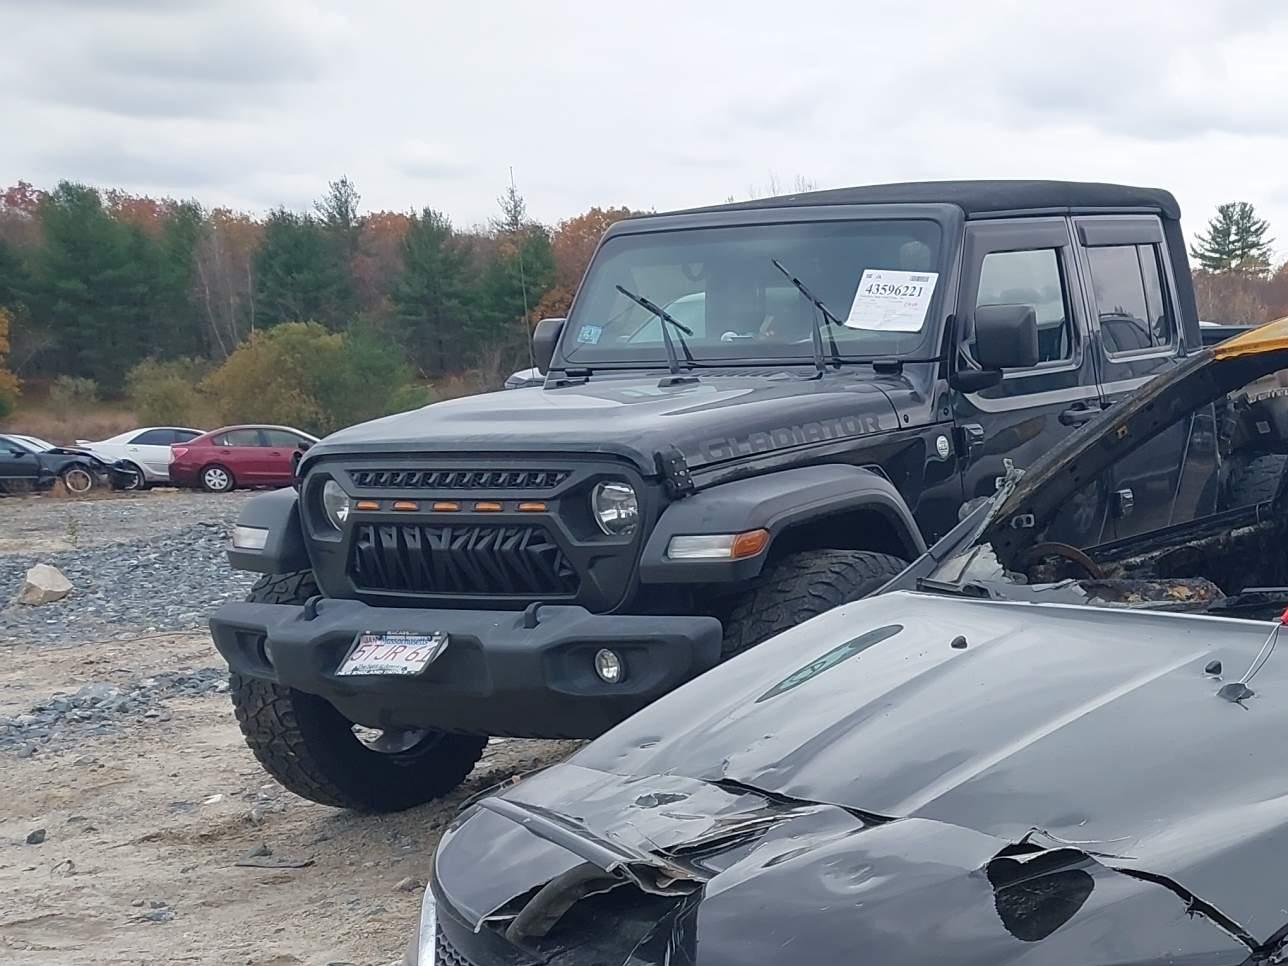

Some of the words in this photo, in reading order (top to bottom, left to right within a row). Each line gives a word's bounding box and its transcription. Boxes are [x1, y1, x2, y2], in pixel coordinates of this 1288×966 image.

[865, 284, 923, 297] 43596221
[702, 414, 880, 463] GLADIATOR
[351, 645, 408, 661] 5TJR
[405, 645, 435, 662] 61
